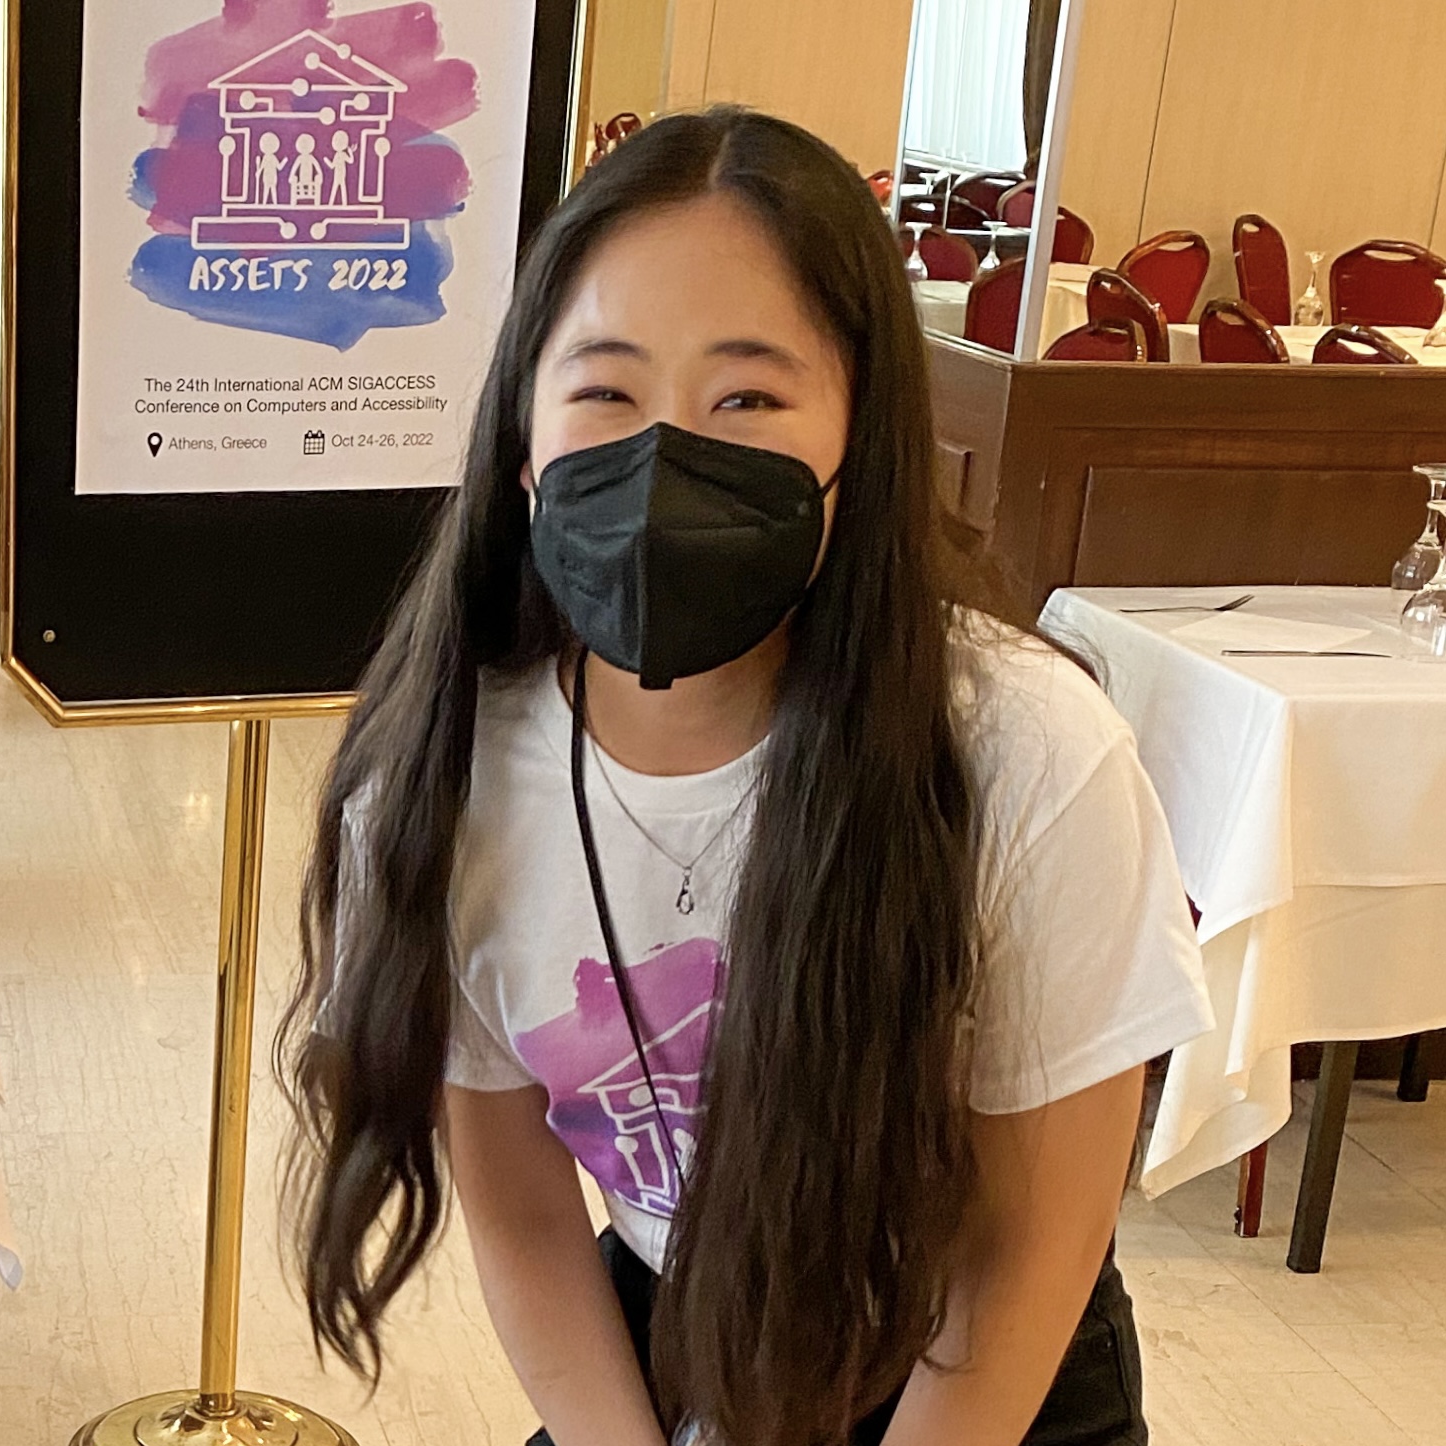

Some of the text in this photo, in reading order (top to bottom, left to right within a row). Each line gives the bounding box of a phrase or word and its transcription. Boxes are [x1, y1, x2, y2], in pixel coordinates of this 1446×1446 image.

[188, 255, 409, 292] ASSETS 2022
[144, 375, 436, 392] The 24th International ACM SIGACCESS
[134, 395, 448, 415] Conference on Computers and Accessibility
[168, 436, 268, 451] Athens, Greece
[331, 432, 434, 448] Oct 24-26, 2022
